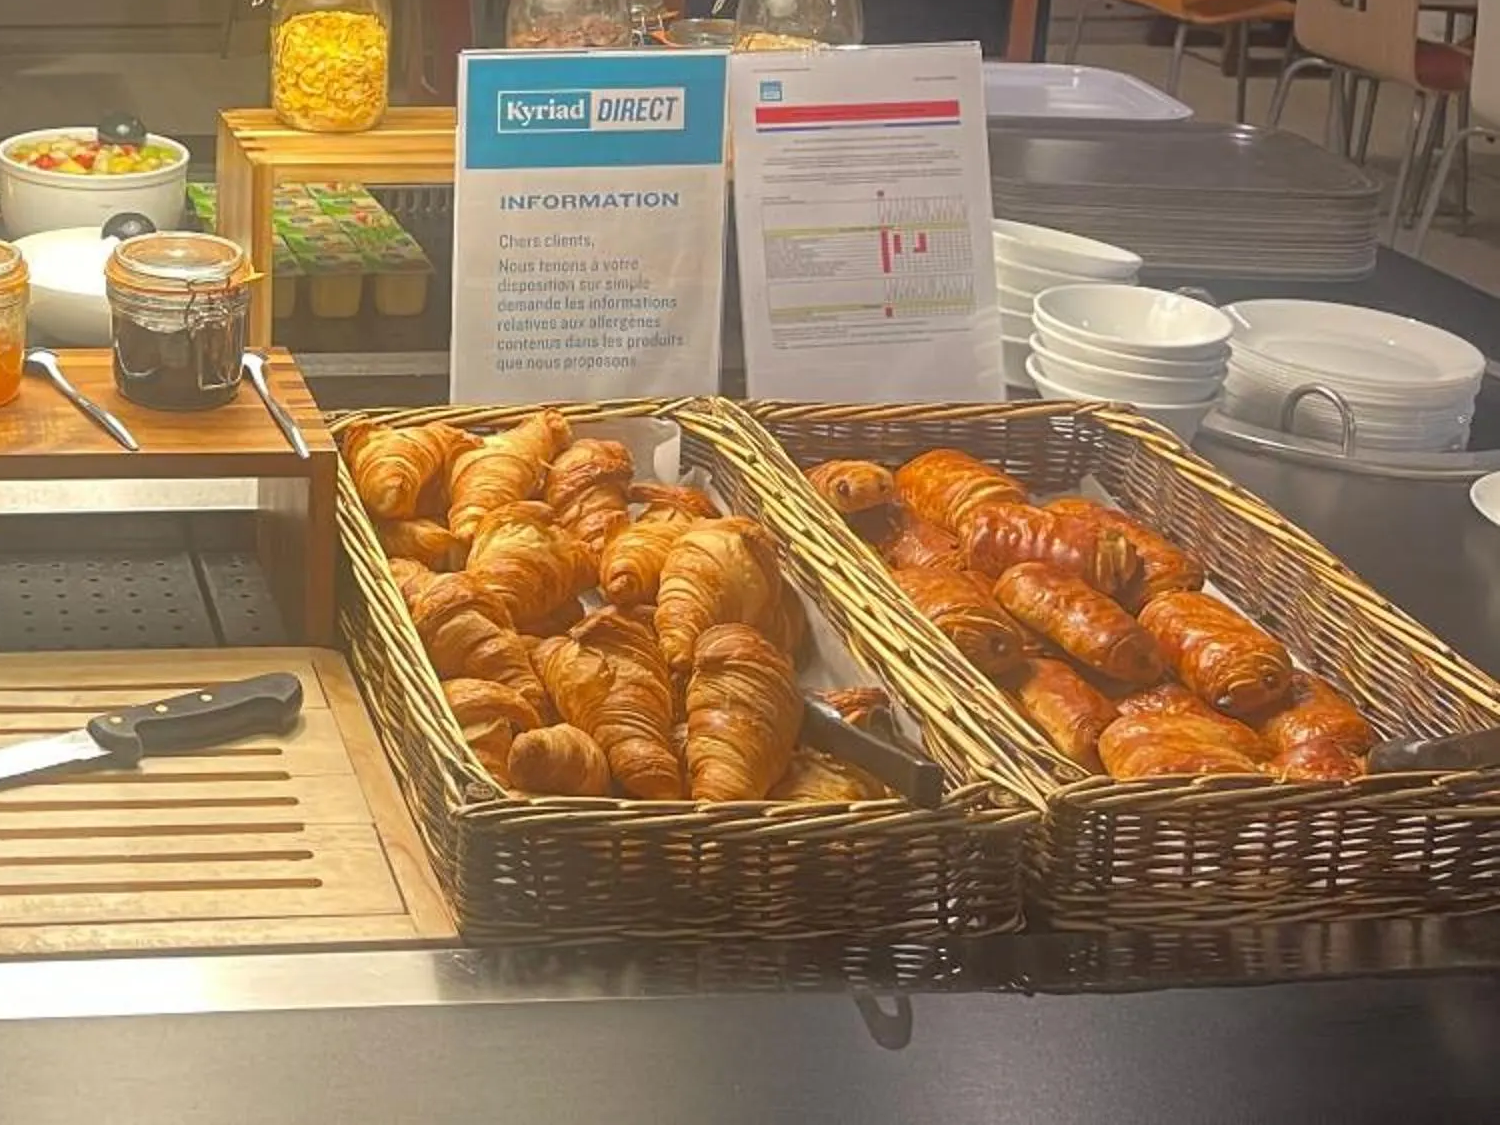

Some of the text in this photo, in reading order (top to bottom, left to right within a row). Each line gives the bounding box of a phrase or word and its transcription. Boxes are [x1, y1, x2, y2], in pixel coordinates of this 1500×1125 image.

[506, 96, 679, 126] Kyriad DIRECT
[500, 191, 680, 210] INFORMATION
[499, 233, 595, 250] Chers clients,
[499, 258, 536, 273] Nous
[539, 259, 587, 273] tenons
[602, 258, 640, 272] votre
[497, 277, 576, 295] disposition
[579, 279, 601, 293] sur
[497, 295, 678, 313] demande les informations
[497, 316, 558, 332] relatives
[560, 318, 586, 330] aux
[497, 331, 685, 352] contenus dans les produits
[496, 357, 523, 373] que
[526, 357, 562, 371] nous
